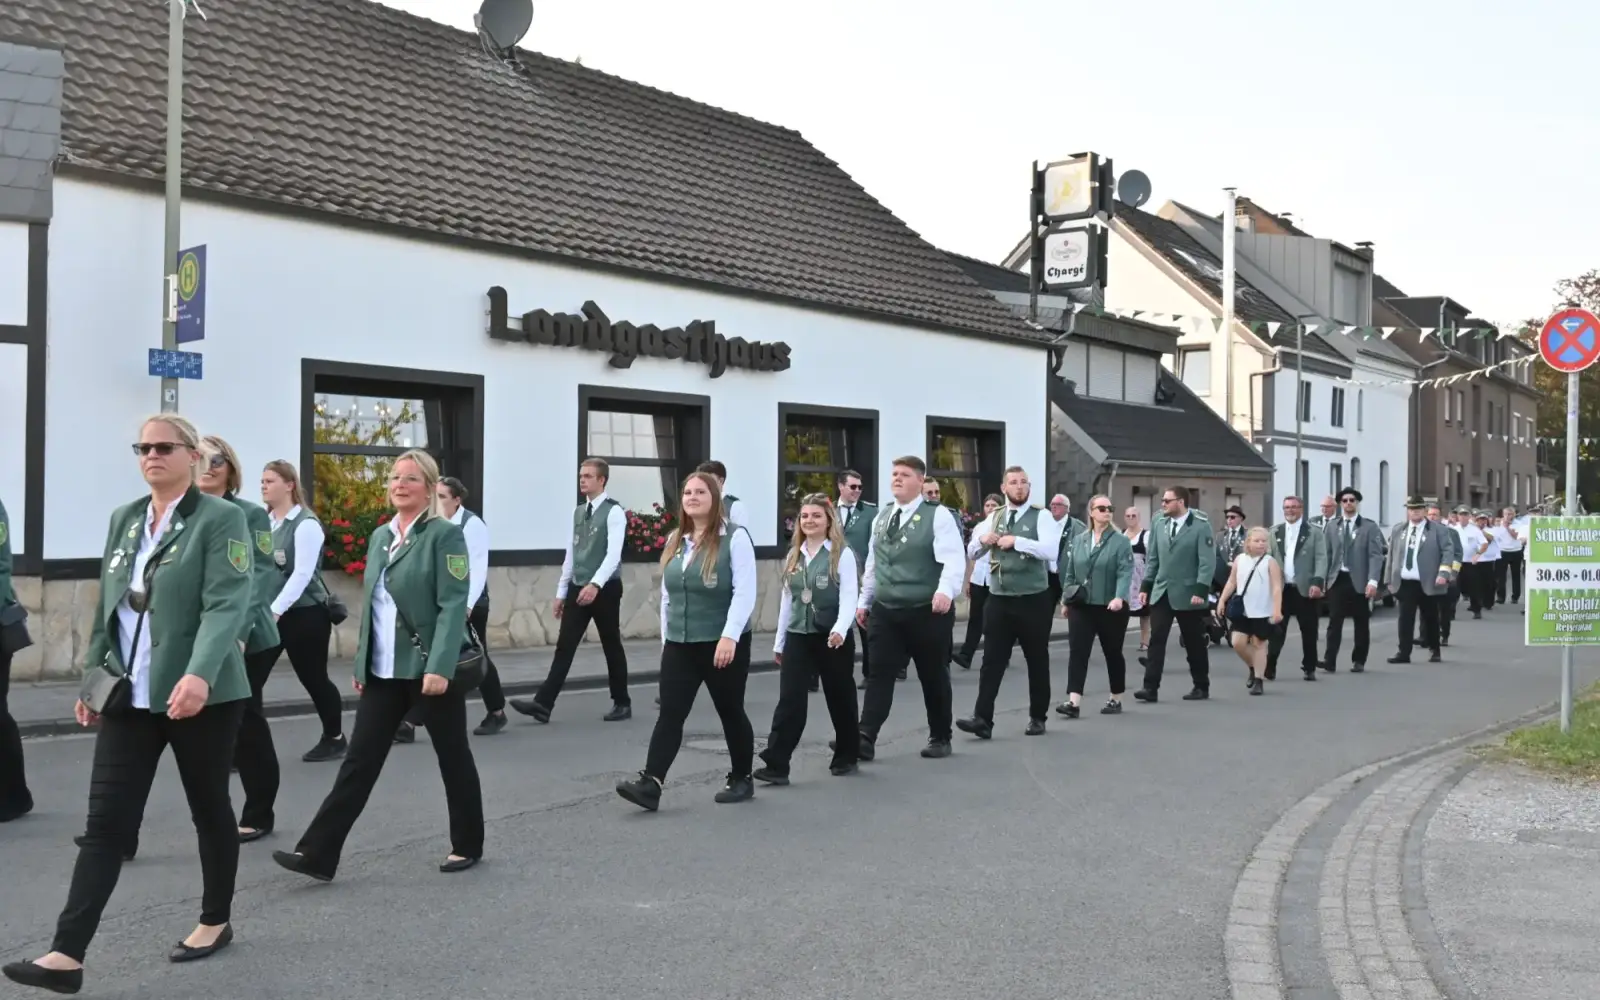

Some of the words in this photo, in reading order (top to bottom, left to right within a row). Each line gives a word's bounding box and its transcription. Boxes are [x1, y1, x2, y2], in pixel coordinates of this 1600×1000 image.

[183, 262, 193, 290] H
[1047, 264, 1084, 278] Chargé
[486, 286, 792, 378] Landgasthaus
[1535, 527, 1600, 542] Schützenfe
[1553, 545, 1564, 557] in
[1567, 545, 1593, 557] Rahm
[1536, 568, 1571, 582] 30.08
[1548, 596, 1600, 612] Festplatz
